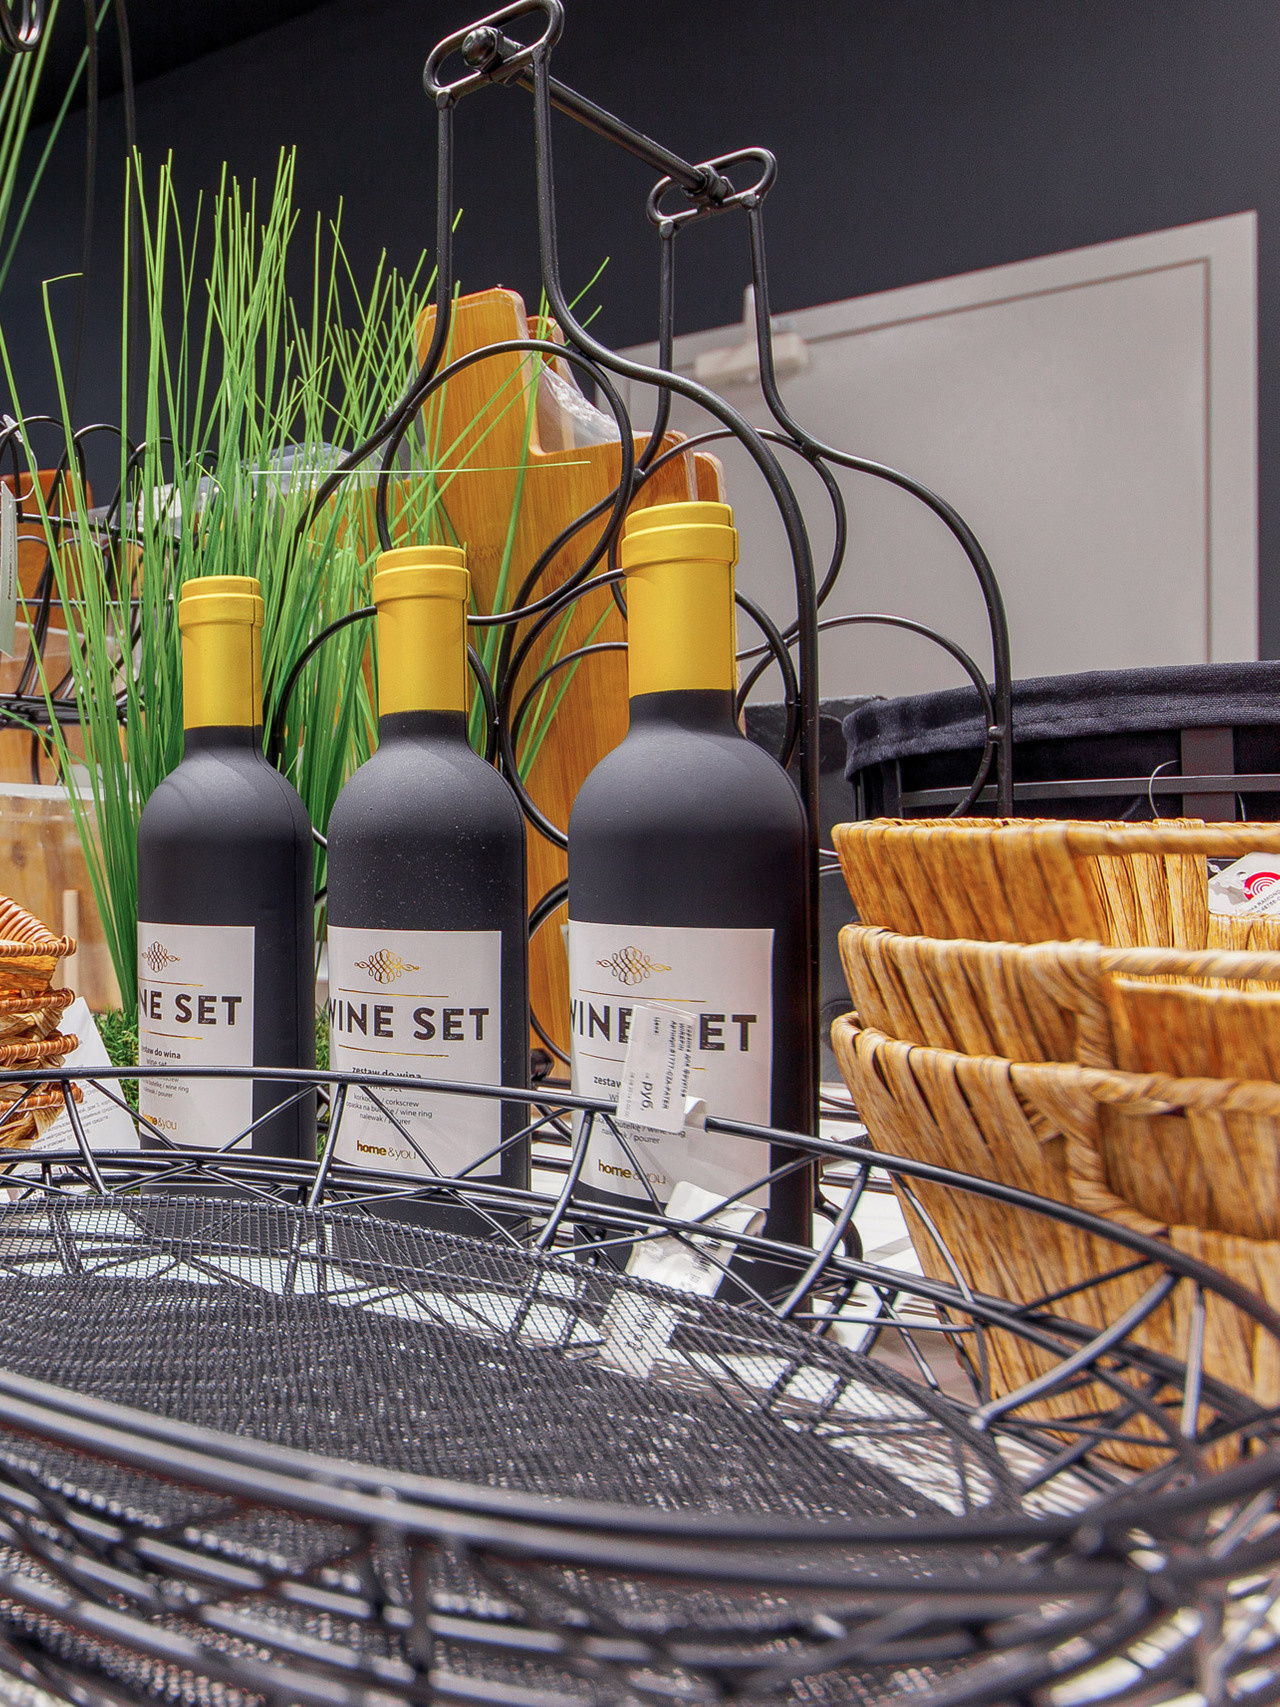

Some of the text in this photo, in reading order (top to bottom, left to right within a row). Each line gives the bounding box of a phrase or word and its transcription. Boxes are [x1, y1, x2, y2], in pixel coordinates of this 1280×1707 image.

[139, 988, 242, 1026] NE SET
[413, 1007, 490, 1041] SET
[699, 1013, 758, 1052] ET
[154, 1047, 163, 1056] do
[163, 1050, 181, 1060] wina
[385, 1098, 419, 1107] corkscrew
[360, 1113, 383, 1122] nalewak
[388, 1118, 411, 1126] purer
[400, 1109, 417, 1117] wine
[418, 1110, 433, 1120] ring
[634, 1134, 660, 1144] pourer
